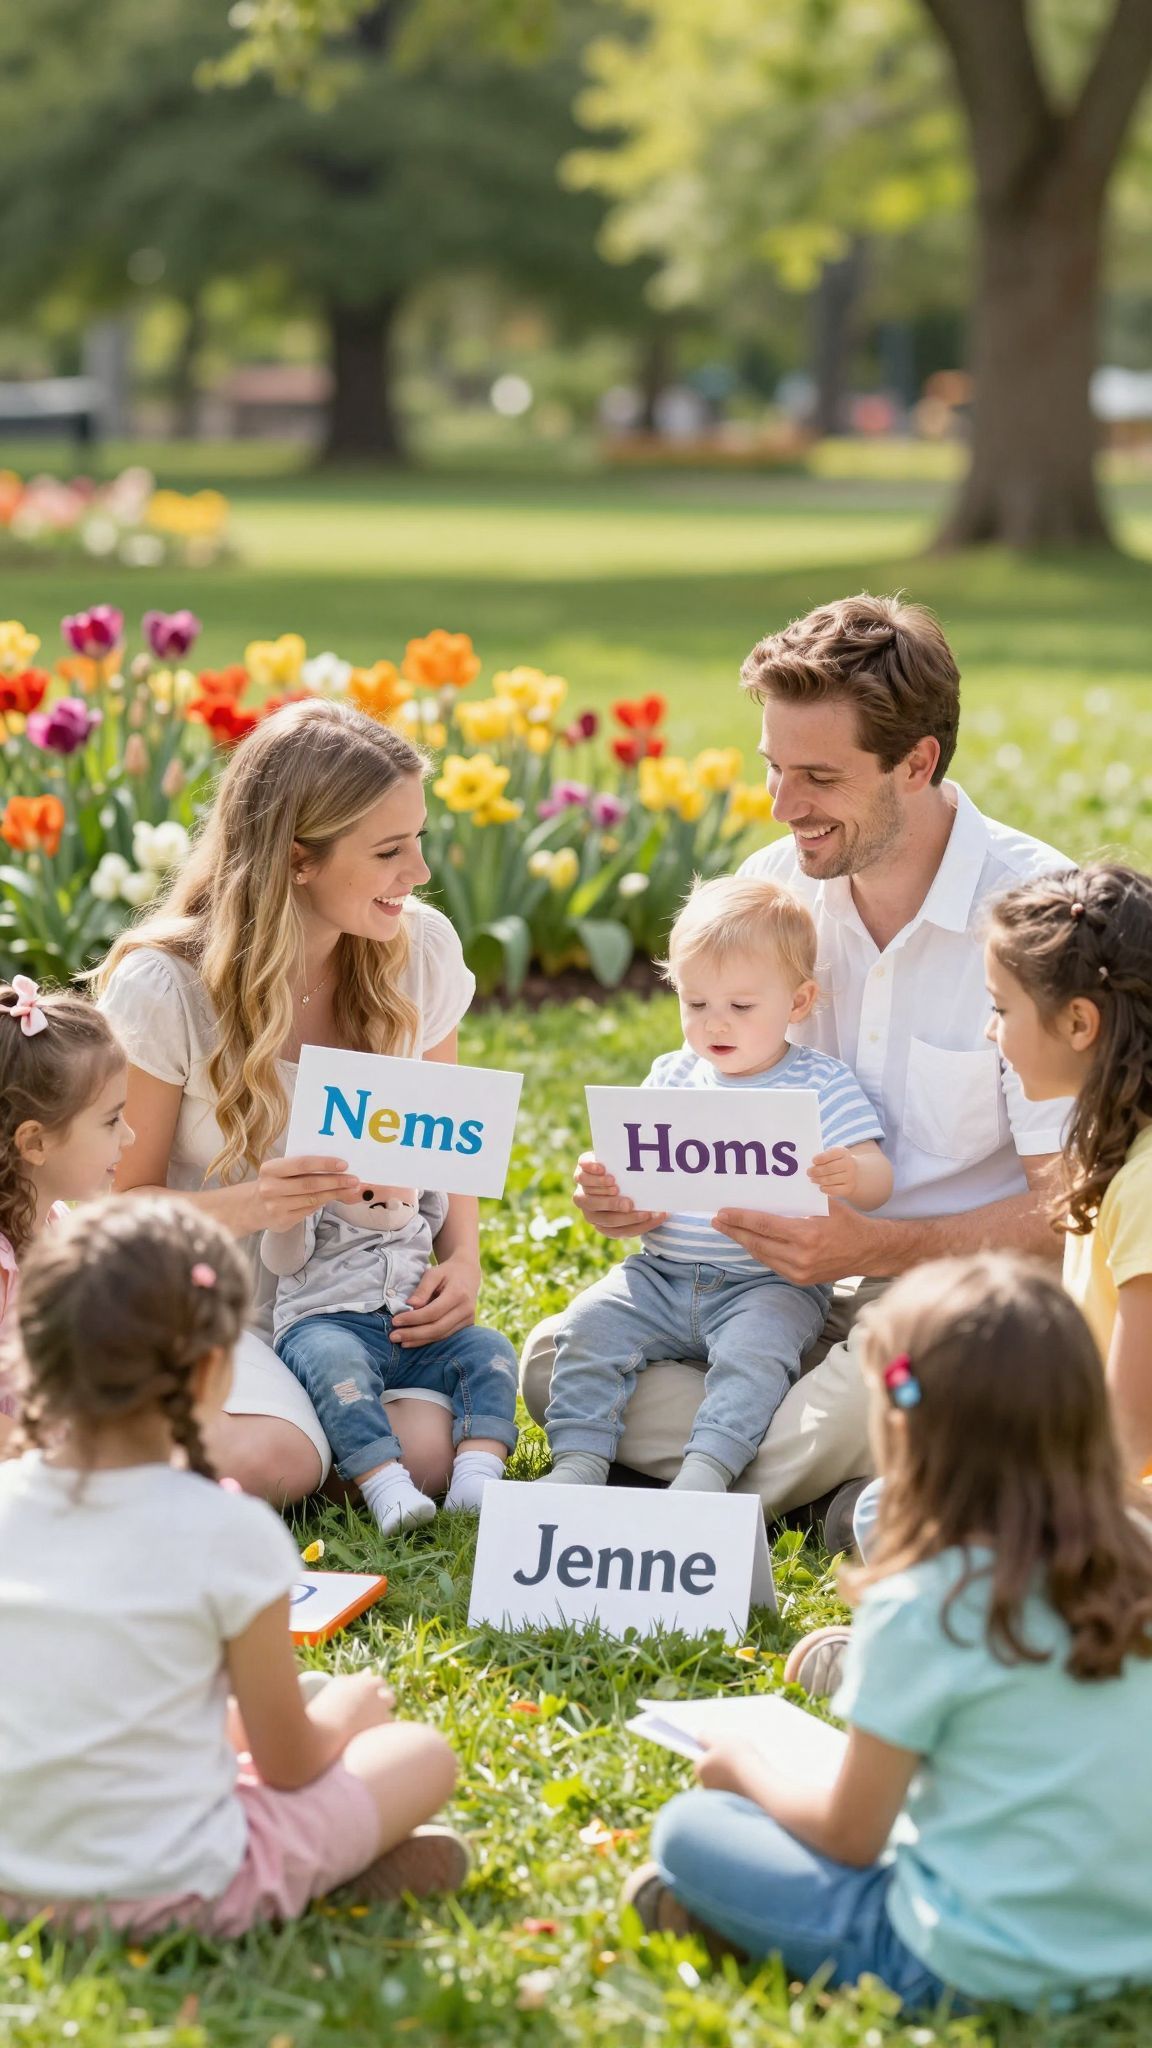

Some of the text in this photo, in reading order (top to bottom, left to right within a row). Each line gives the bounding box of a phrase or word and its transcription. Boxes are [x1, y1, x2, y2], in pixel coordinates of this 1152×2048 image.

[317, 1085, 485, 1156] Nems
[623, 1122, 799, 1177] Homs
[512, 1523, 717, 1596] Jenne
